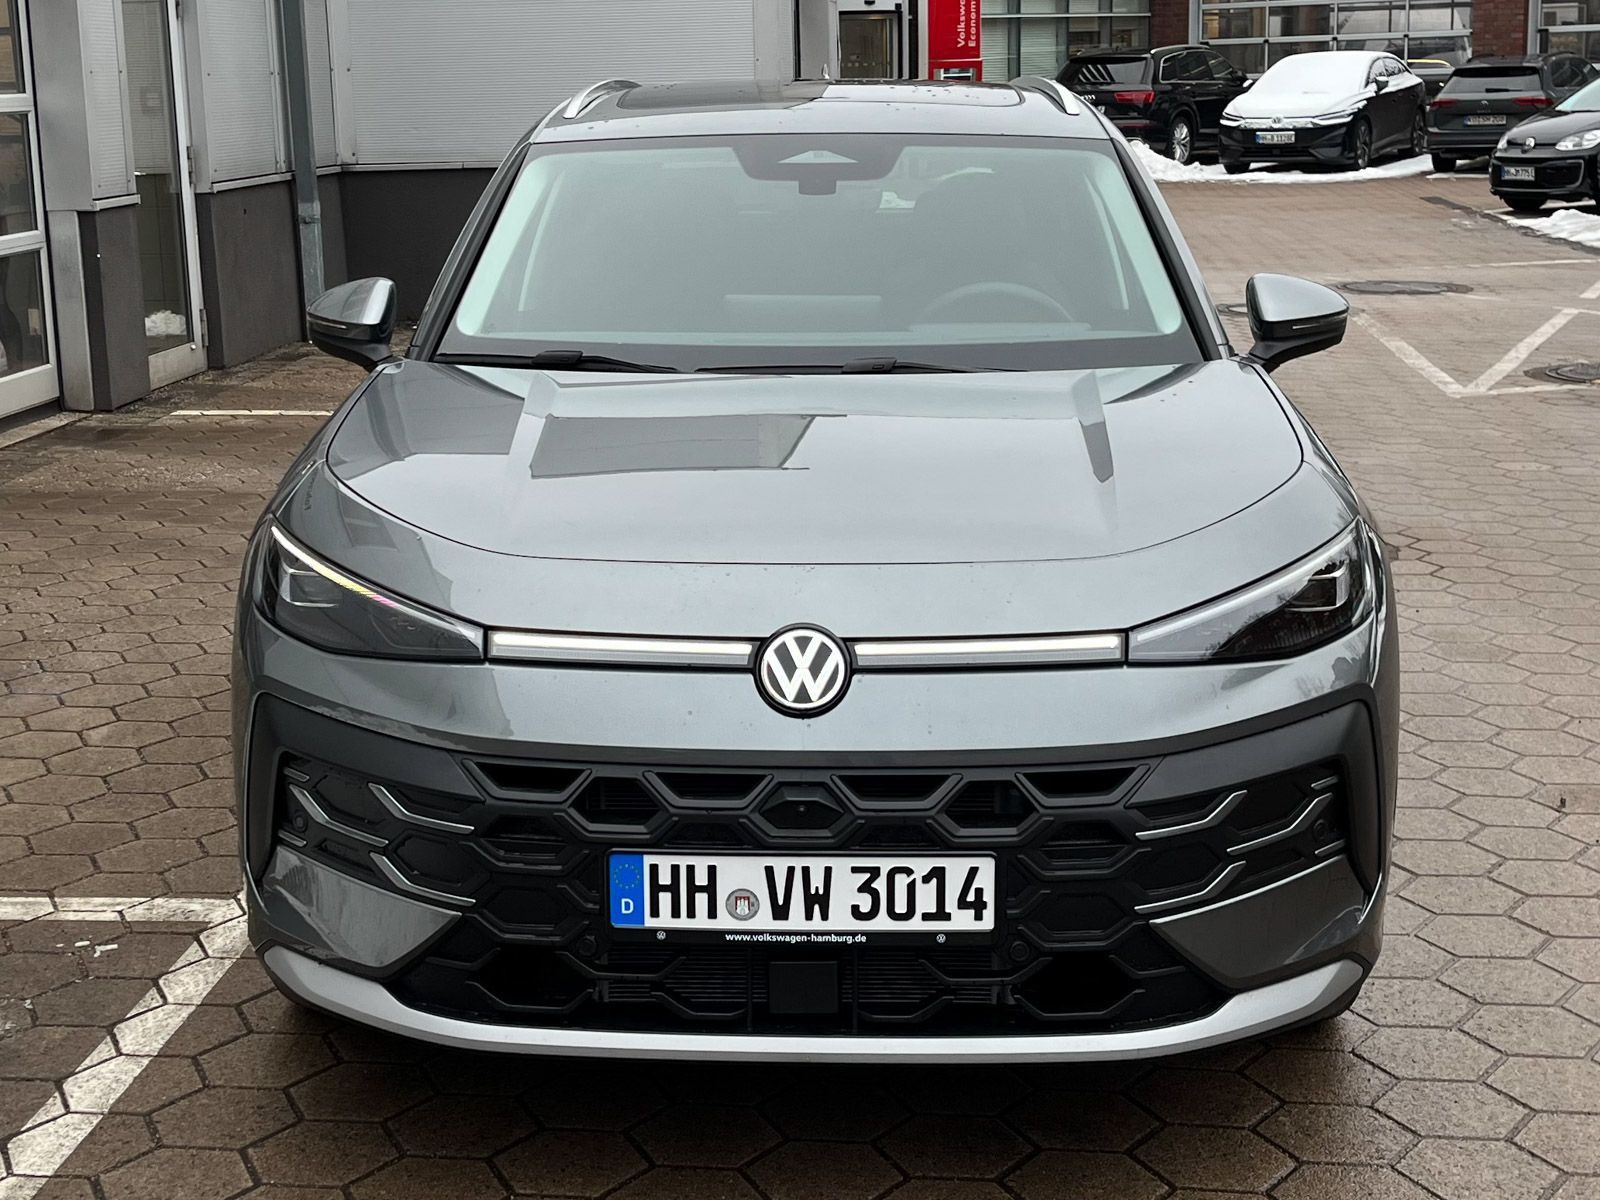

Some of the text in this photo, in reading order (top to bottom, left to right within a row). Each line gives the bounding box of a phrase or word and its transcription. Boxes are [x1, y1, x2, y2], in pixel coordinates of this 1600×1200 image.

[968, 0, 976, 47] Econom
[763, 631, 844, 707] VW
[621, 898, 634, 914] D
[649, 864, 988, 922] HH VW 3014
[725, 933, 867, 944] www.volkswagen-hamburg.de
